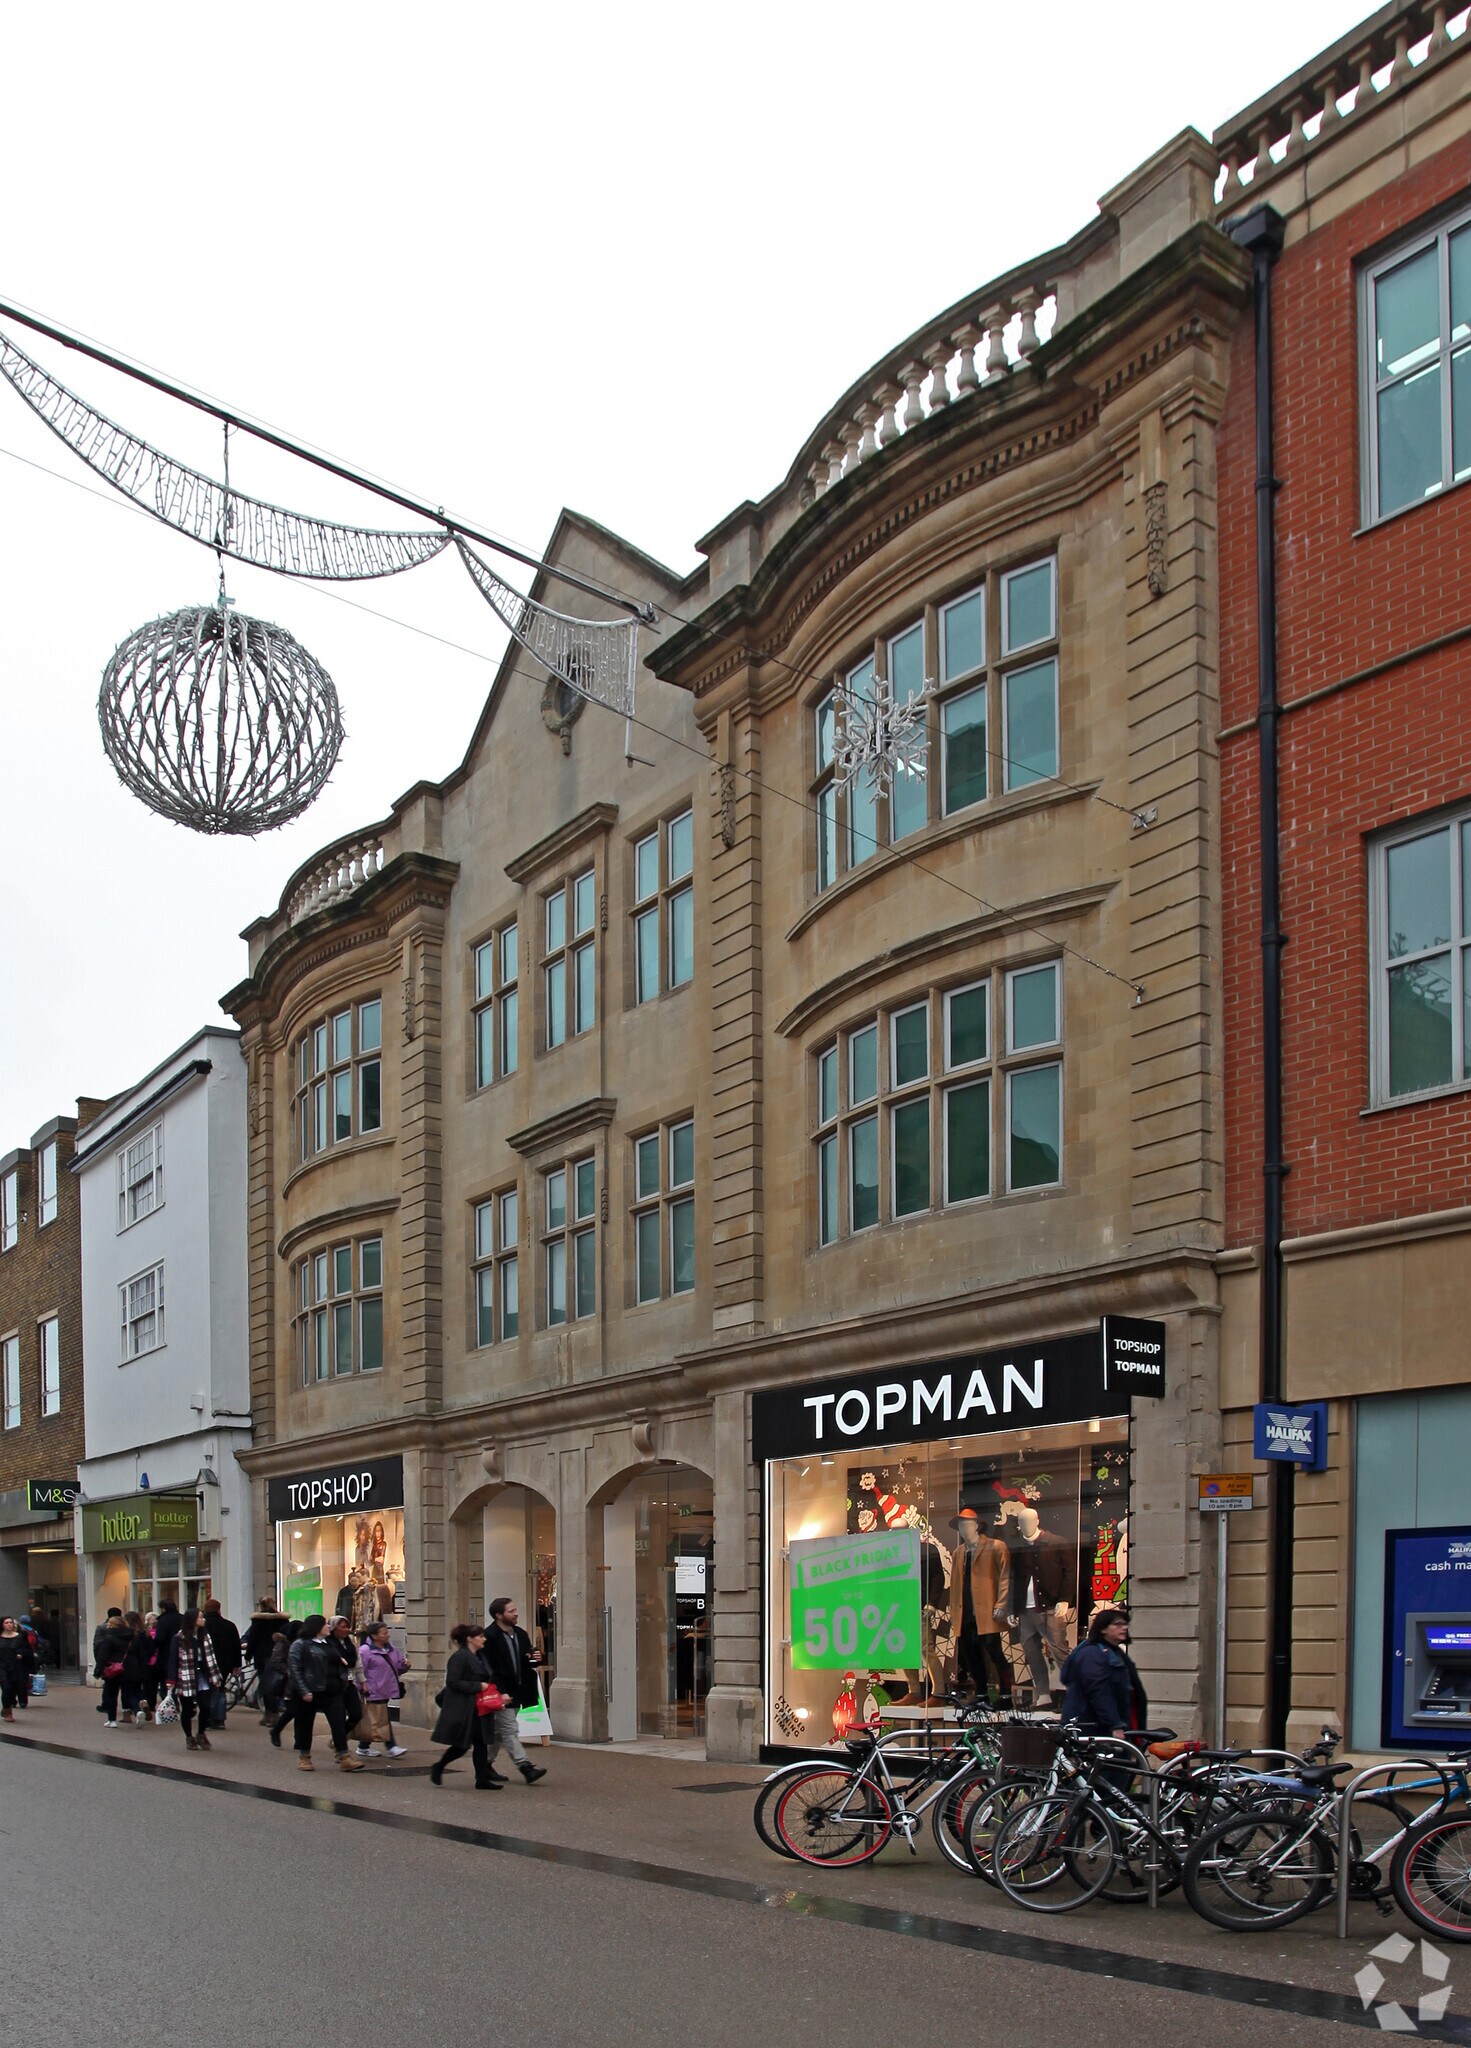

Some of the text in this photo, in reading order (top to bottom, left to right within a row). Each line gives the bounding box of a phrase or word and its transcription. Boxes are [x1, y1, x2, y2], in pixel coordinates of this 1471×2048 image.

[1113, 1338, 1161, 1354] TOPSHOP
[1115, 1360, 1160, 1375] TOPMAN
[803, 1359, 1044, 1439] TOPMAN
[1265, 1425, 1312, 1442] HALIFAX
[35, 1488, 75, 1504] M&S
[287, 1472, 373, 1511] TOPSHOP
[101, 1511, 141, 1543] hotter
[154, 1512, 193, 1524] hotter
[697, 1564, 705, 1574] G
[810, 1544, 899, 1578] BLACK FRIDAY
[1425, 1561, 1451, 1571] cash
[697, 1599, 705, 1609] B
[804, 1602, 906, 1657] 50%
[775, 1703, 799, 1738] OPENING
[778, 1695, 805, 1732] EXTENDED
[773, 1714, 791, 1738] TIMES
